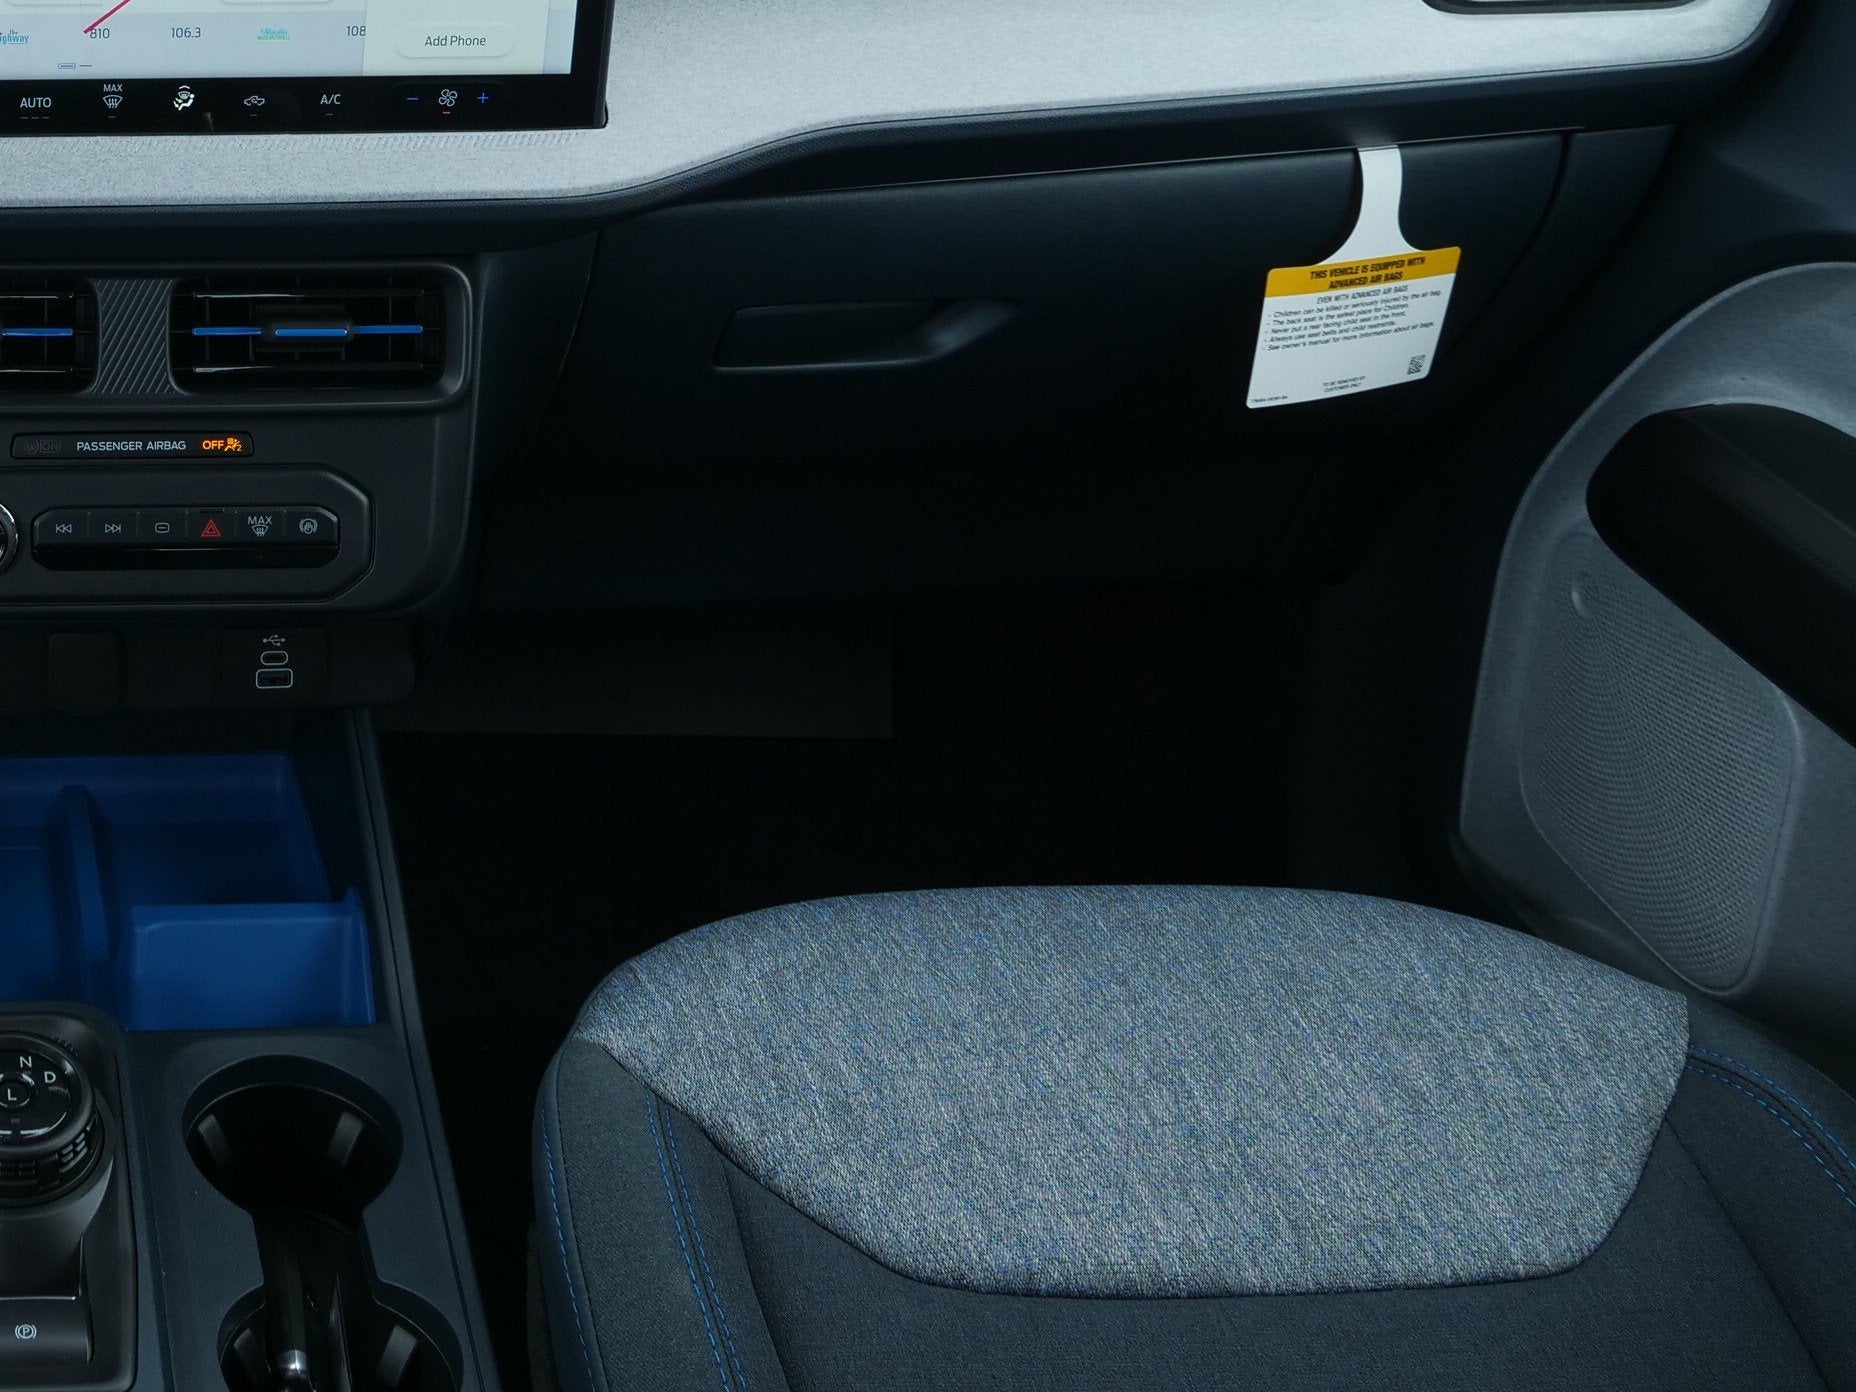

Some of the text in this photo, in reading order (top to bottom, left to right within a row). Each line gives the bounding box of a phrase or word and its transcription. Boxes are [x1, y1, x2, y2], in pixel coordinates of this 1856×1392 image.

[89, 27, 202, 40] 810 106.3
[424, 35, 486, 47] Add Phone
[103, 84, 123, 92] MAX
[20, 97, 52, 109] AUTO
[320, 94, 341, 105] A/C
[1310, 257, 1425, 279] THIS VEHICLE IS EQUIPPED WITH
[1329, 272, 1403, 288] ADVANCED AIR BAGS
[1351, 289, 1381, 298] ADVANCED
[77, 440, 187, 451] PASSENGER AIRBAG
[202, 440, 224, 450] OFF
[247, 516, 273, 526] MAX
[20, 1055, 32, 1068] N
[44, 1071, 56, 1084] D
[7, 1088, 17, 1101] L
